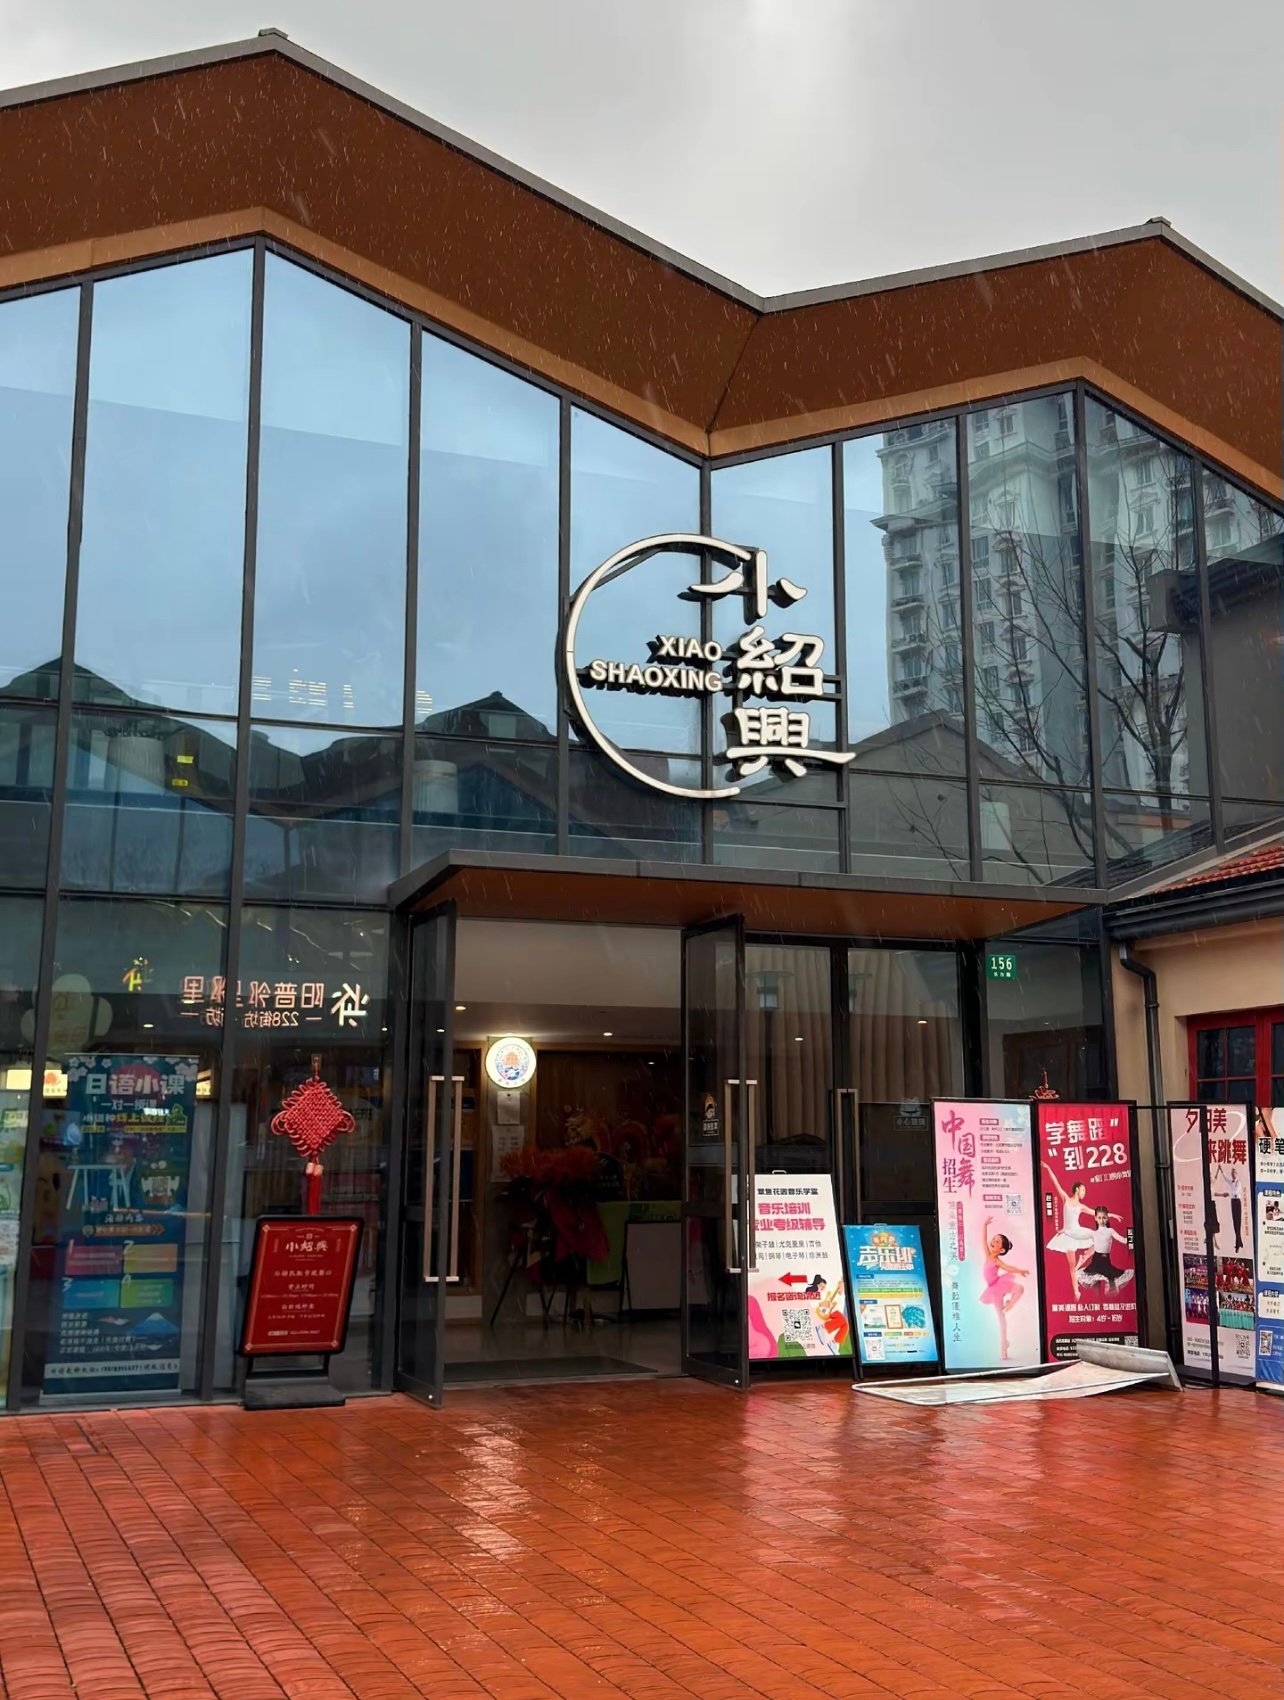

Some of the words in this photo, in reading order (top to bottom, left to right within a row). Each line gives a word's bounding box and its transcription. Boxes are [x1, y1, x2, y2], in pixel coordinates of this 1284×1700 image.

[656, 634, 723, 662] XIAO
[589, 659, 723, 692] SHAOXING
[991, 957, 1012, 970] 156
[85, 1073, 185, 1095] 日语小课
[942, 1157, 958, 1194] 招生
[758, 1202, 811, 1215] 音乐培训
